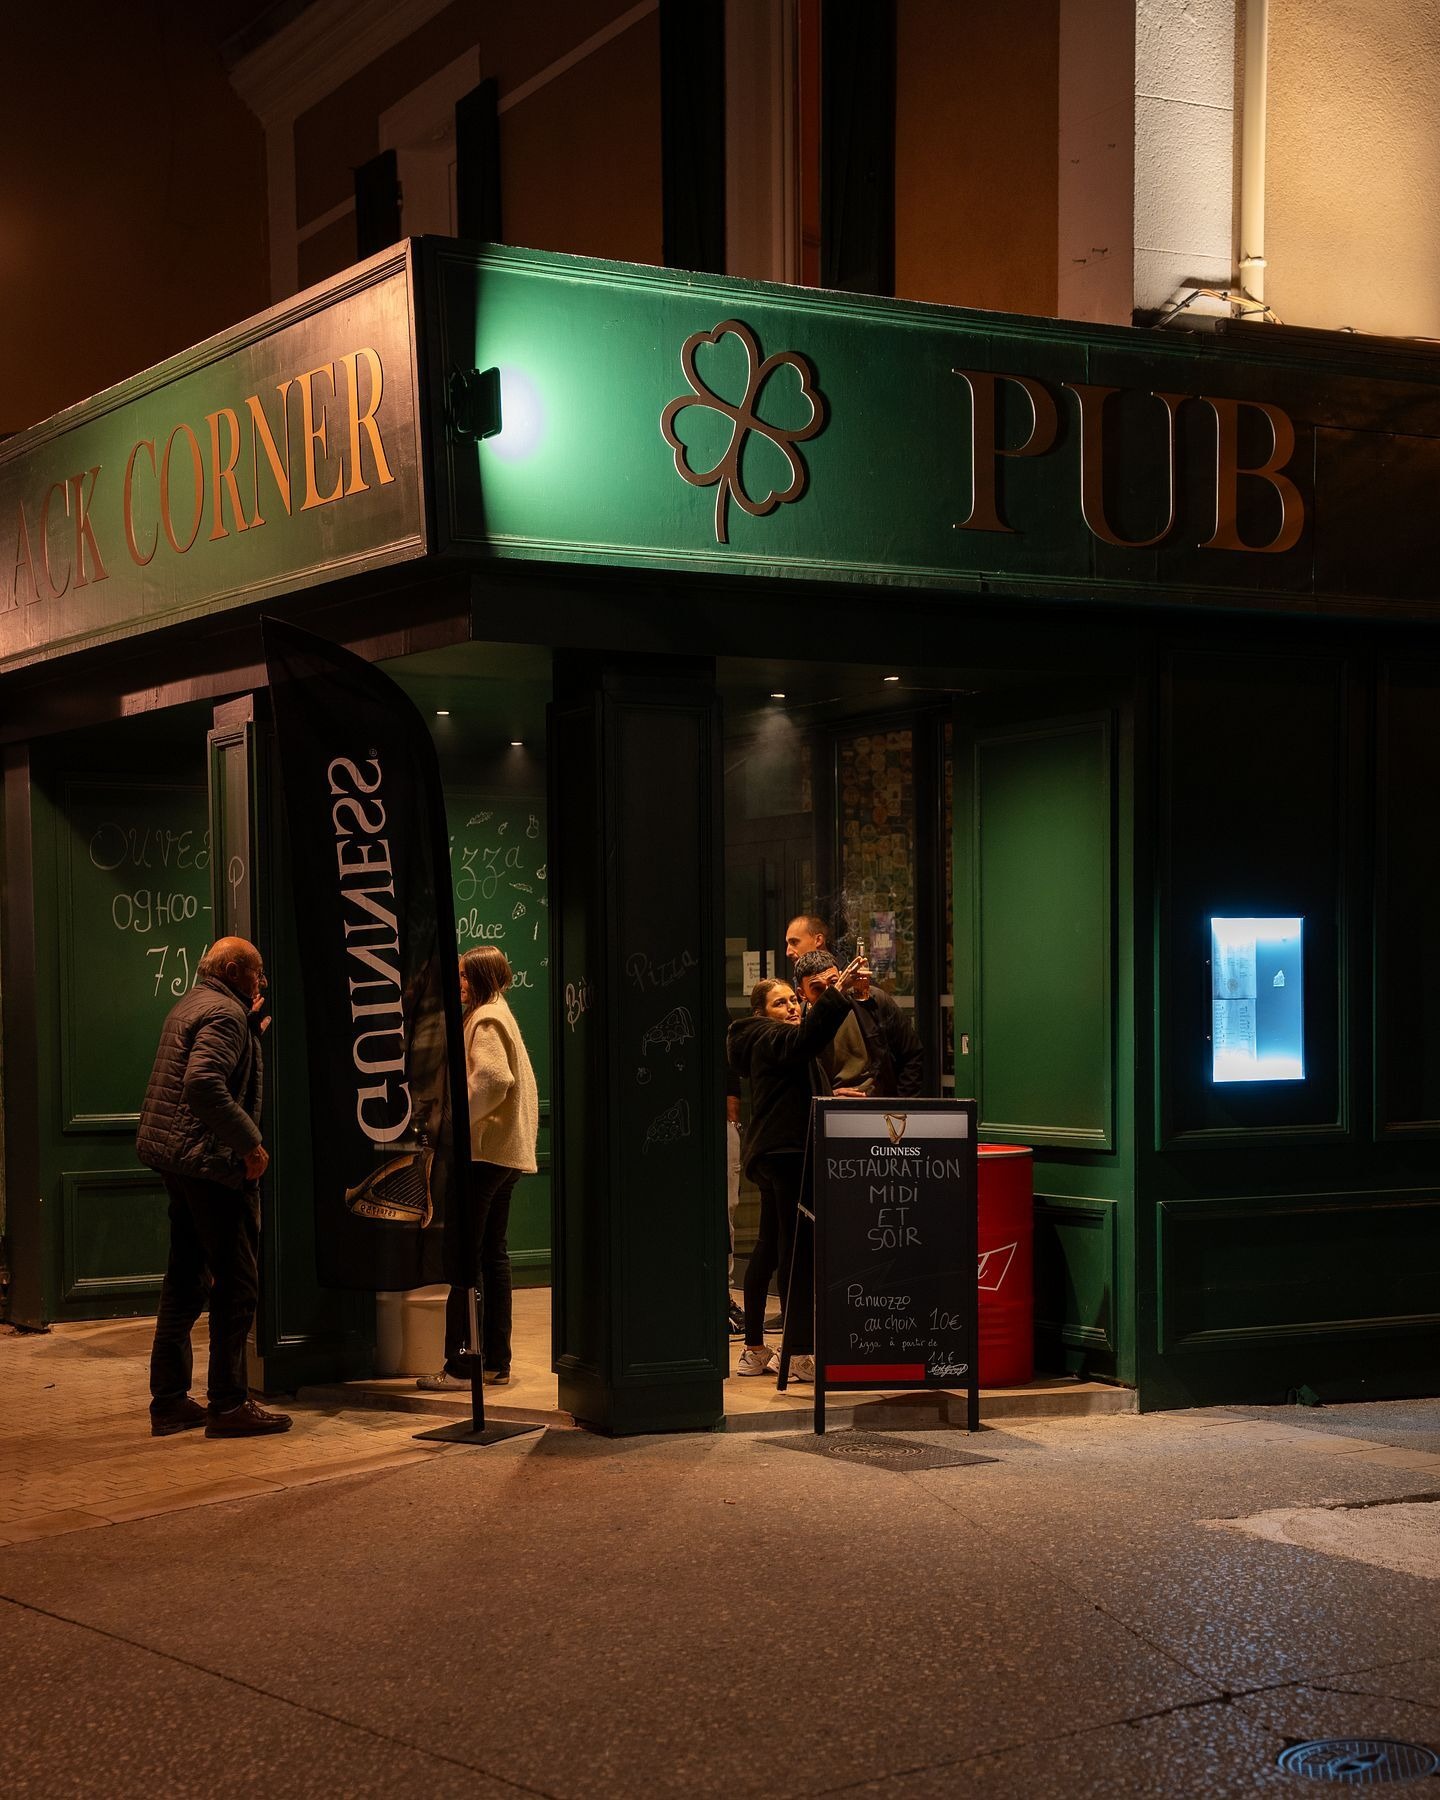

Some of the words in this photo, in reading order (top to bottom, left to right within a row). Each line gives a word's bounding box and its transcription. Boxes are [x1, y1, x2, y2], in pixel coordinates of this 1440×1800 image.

[952, 367, 1305, 554] PUB
[0, 464, 109, 614] ACK
[123, 346, 396, 567] CORNER
[449, 835, 525, 901] izza
[870, 1144, 921, 1157] GUINNESS
[878, 1207, 911, 1228] ET
[867, 1225, 923, 1252] SOIR
[847, 1283, 912, 1311] Panuozzo
[864, 1317, 882, 1333] au
[884, 1314, 918, 1334] choix
[929, 1307, 963, 1331] 10€
[902, 1337, 926, 1352] partir
